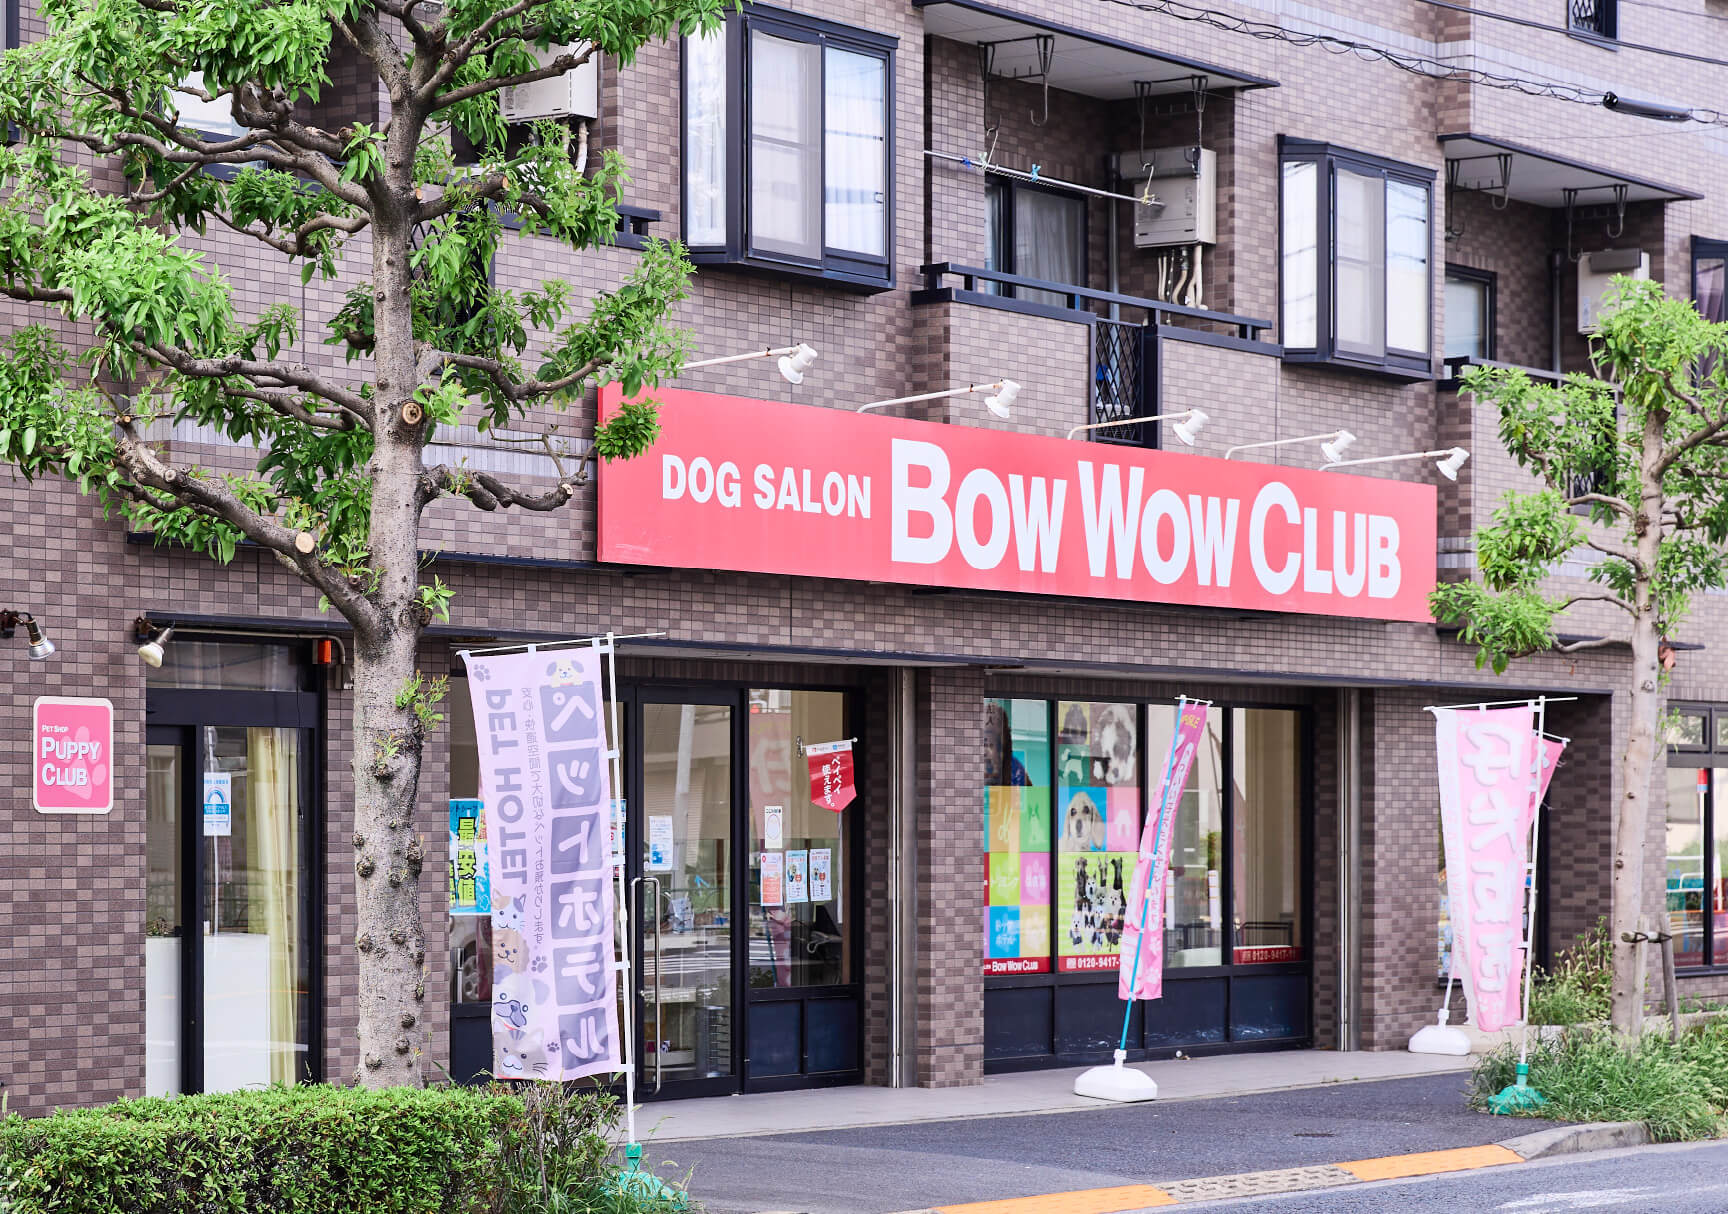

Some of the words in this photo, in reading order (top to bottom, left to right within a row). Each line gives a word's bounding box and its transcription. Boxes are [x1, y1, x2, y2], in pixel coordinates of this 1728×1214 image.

[662, 454, 741, 508] DOG
[753, 463, 871, 519] SALON
[891, 438, 1067, 574] BOW
[1077, 460, 1240, 588] WOW
[1249, 481, 1401, 599] CLUB
[42, 736, 100, 760] PUPPY
[42, 763, 88, 786] CLUB
[832, 755, 842, 795] ペイペイ
[1078, 957, 1121, 969] 0120-9417-
